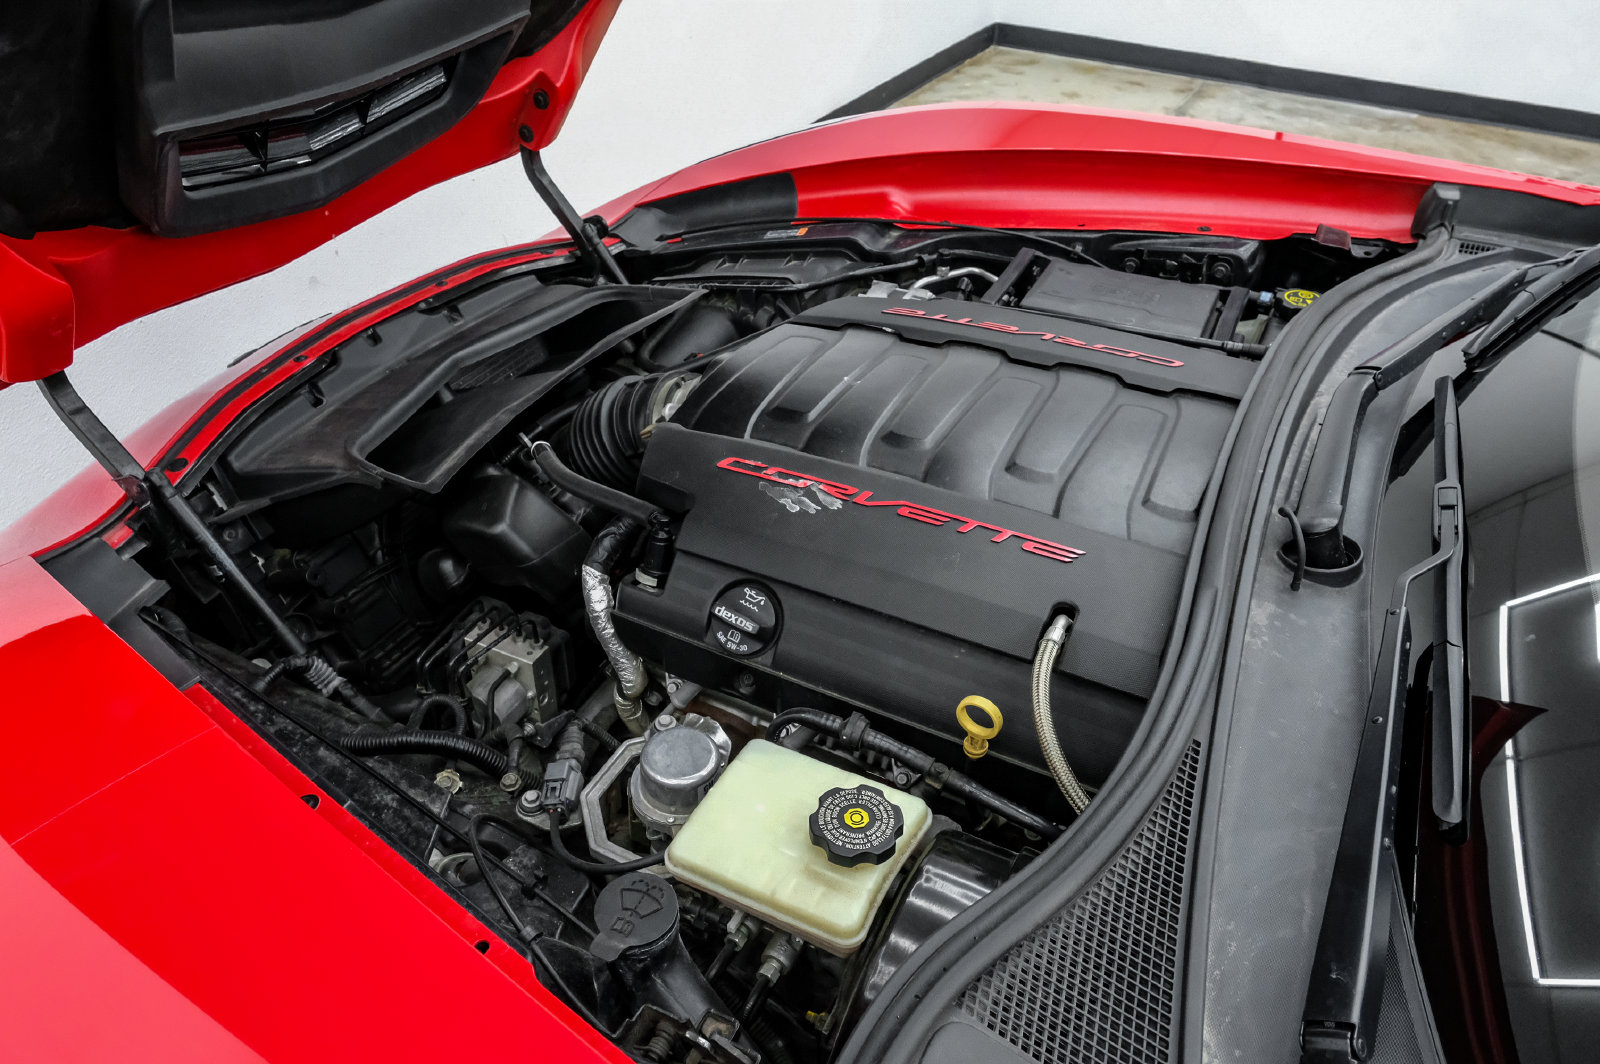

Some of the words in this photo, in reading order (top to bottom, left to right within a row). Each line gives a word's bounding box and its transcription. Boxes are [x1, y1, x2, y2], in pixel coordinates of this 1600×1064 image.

[881, 307, 1185, 368] CORVETTE
[716, 456, 1087, 563] CORVETTE
[714, 605, 754, 632] dexos
[716, 631, 727, 644] SAE
[726, 641, 748, 652] 5W-30
